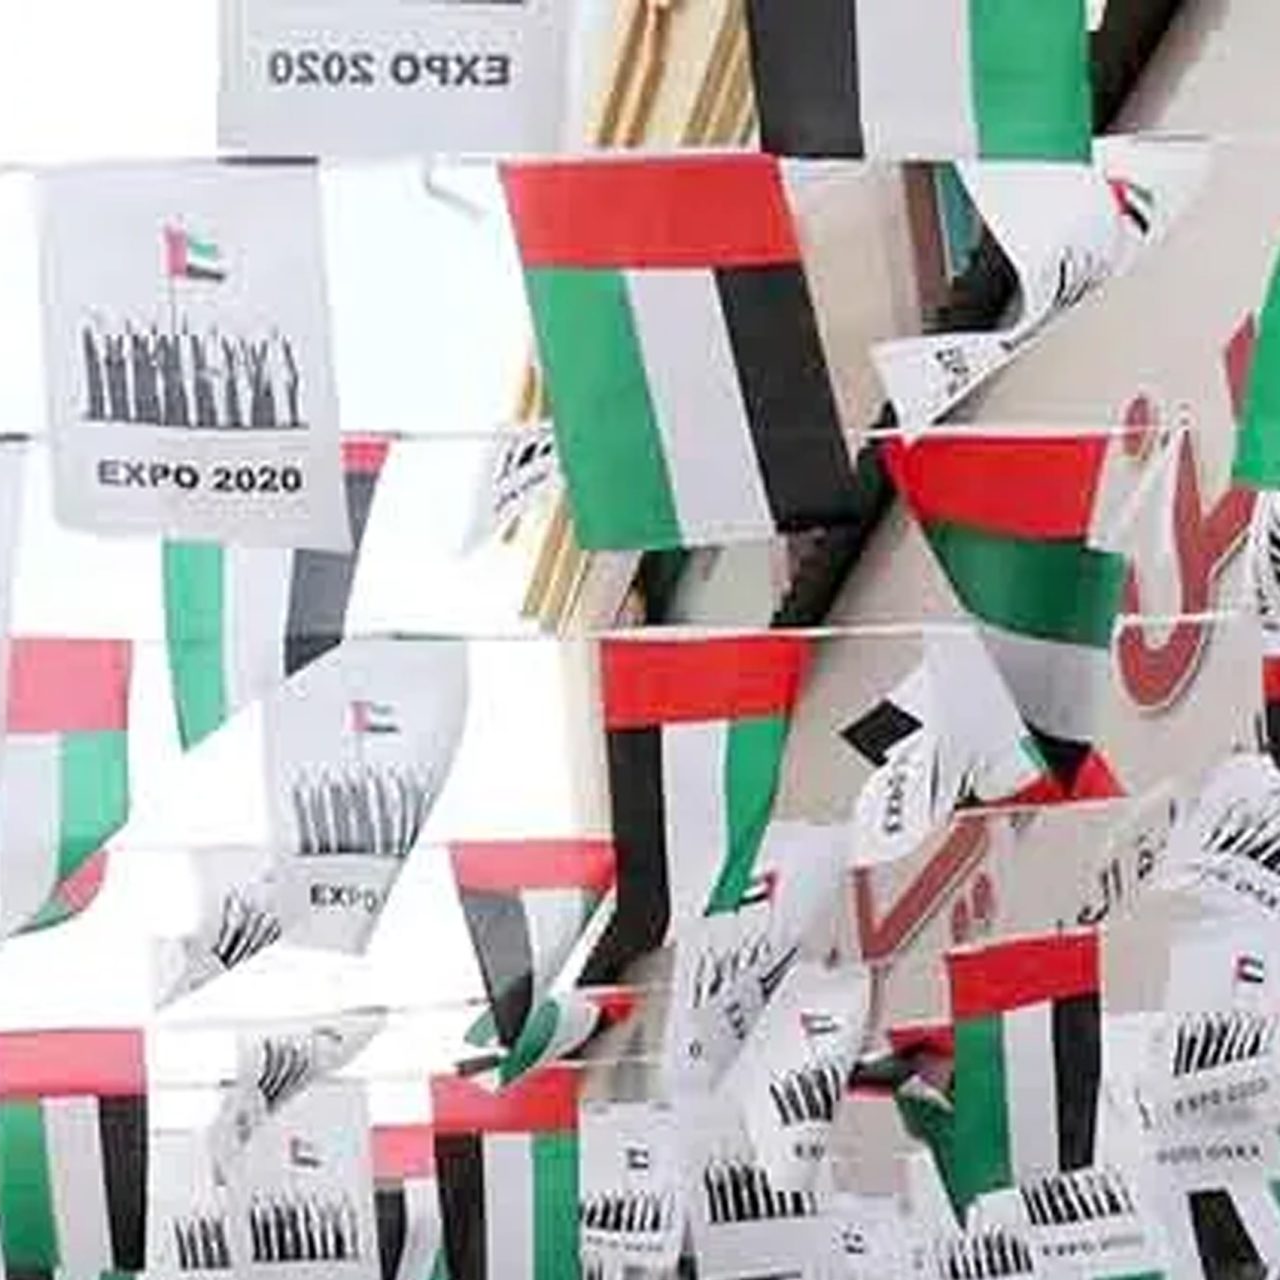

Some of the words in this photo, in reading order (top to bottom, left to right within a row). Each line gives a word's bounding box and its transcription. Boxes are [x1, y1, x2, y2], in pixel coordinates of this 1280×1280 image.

[96, 458, 200, 490] EXPO
[210, 464, 303, 493] 2020
[308, 881, 378, 914] EXPO
